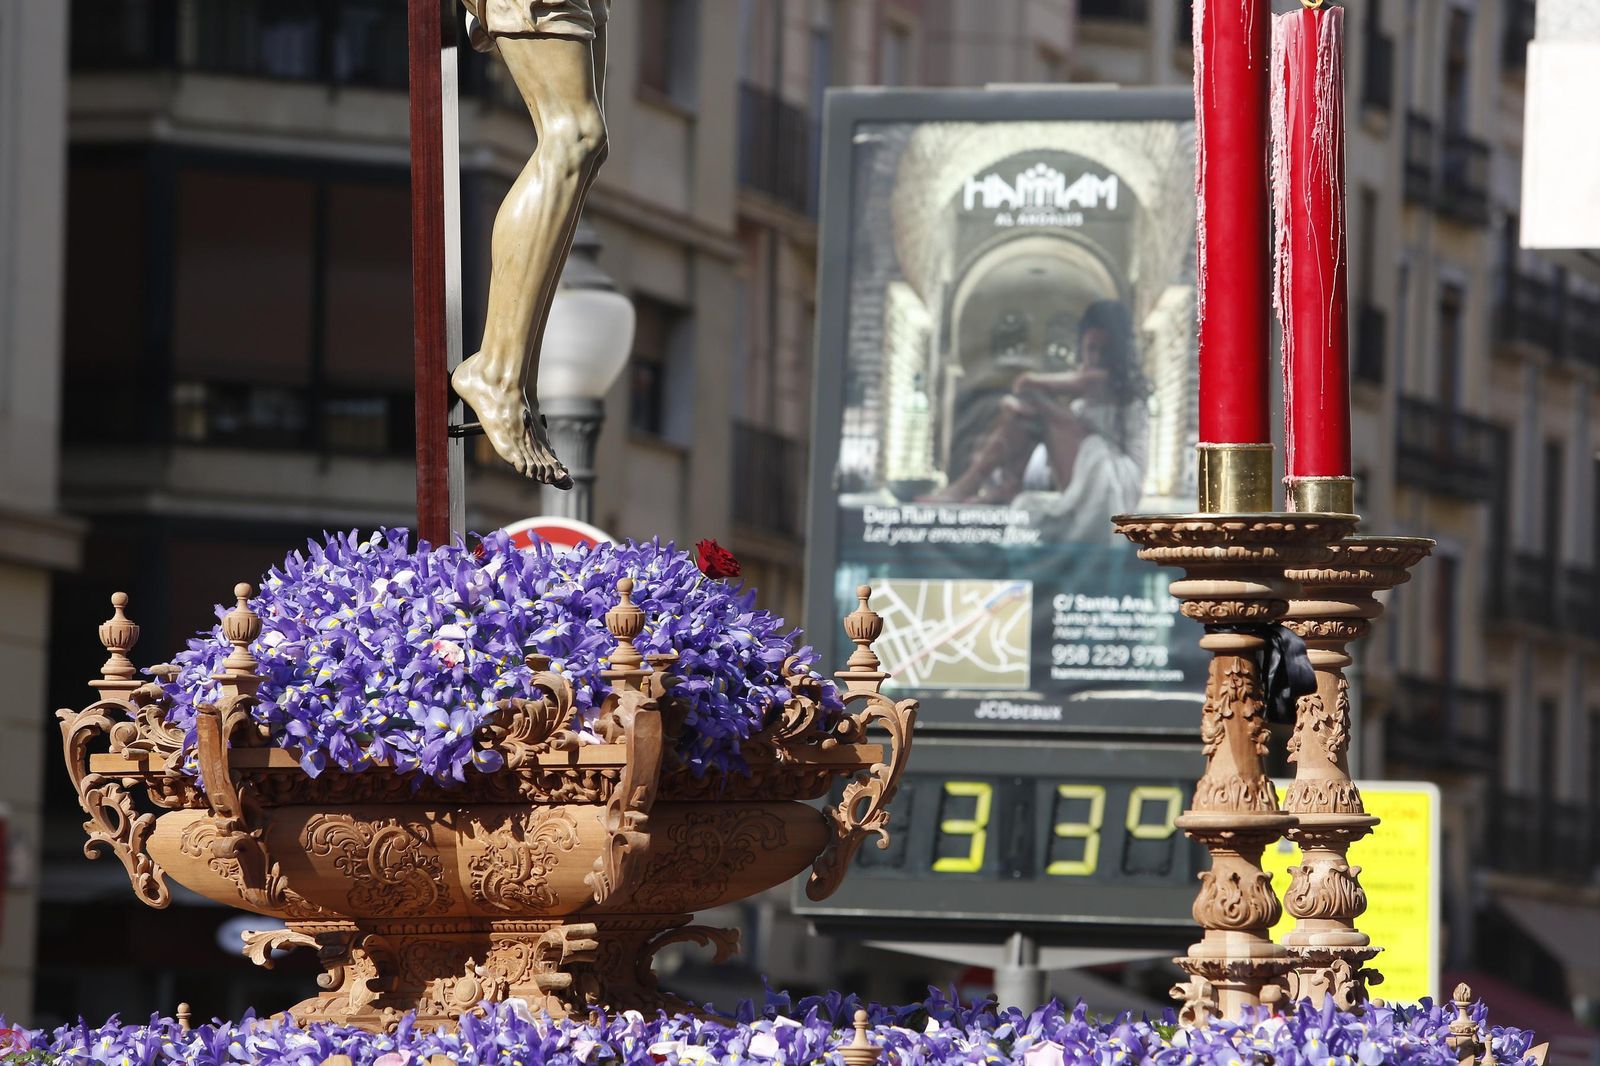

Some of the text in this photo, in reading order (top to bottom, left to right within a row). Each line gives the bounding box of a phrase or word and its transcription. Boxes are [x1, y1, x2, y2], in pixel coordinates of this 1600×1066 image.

[889, 527, 927, 546] your
[1075, 594, 1120, 612] Santa
[1052, 643, 1090, 666] 958
[1091, 644, 1130, 667] 229
